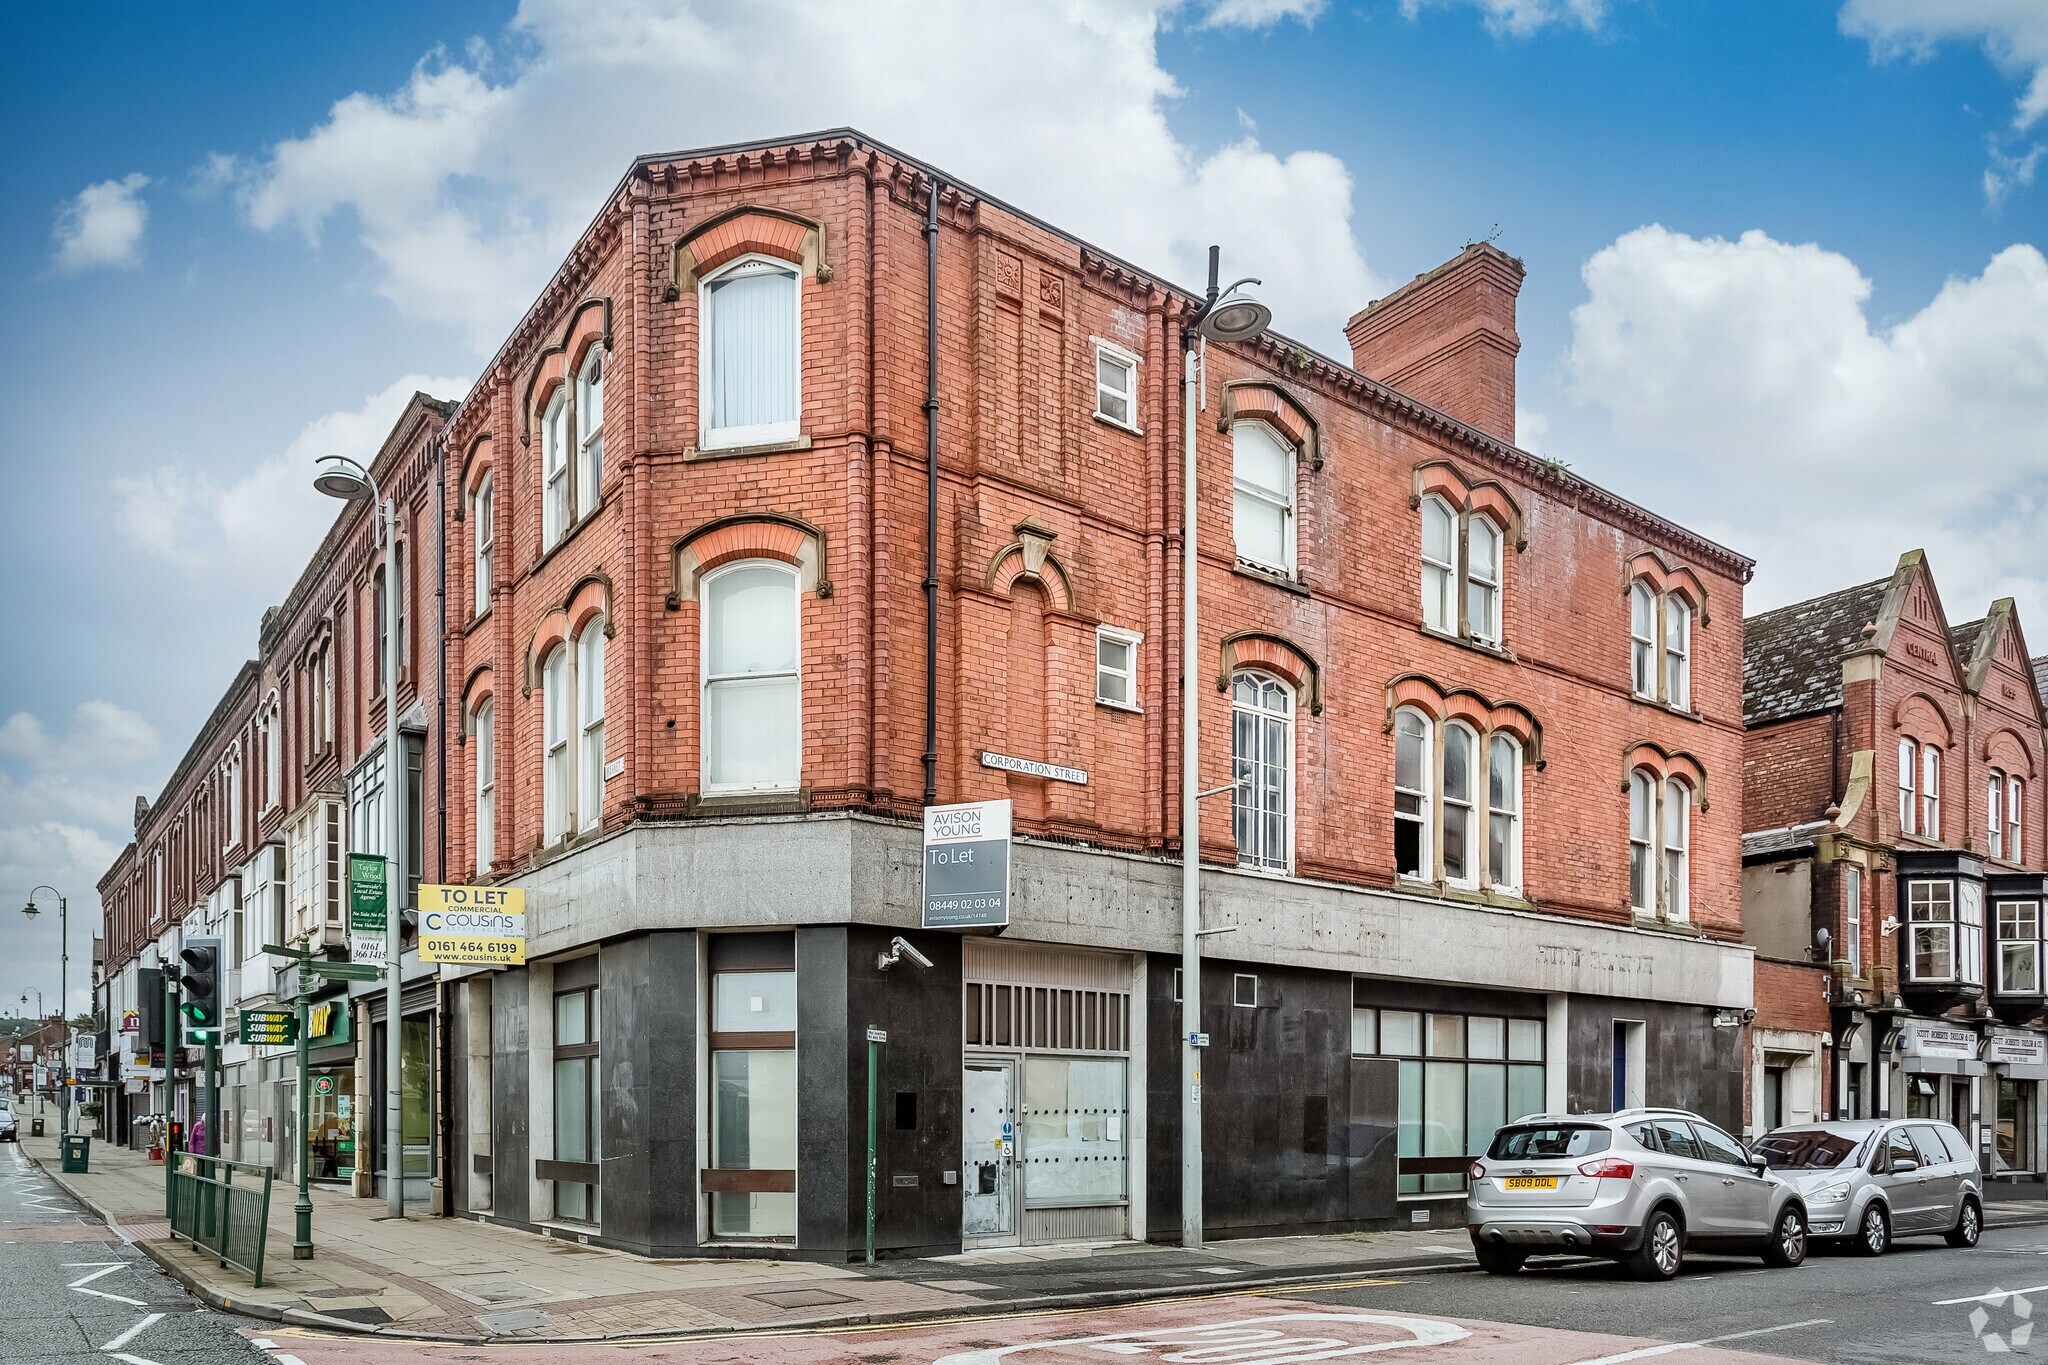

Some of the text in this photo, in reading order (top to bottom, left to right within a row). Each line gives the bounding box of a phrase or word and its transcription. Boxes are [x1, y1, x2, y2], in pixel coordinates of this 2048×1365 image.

[984, 753, 1086, 782] CORPORATION STREET
[933, 810, 980, 825] AVISON
[933, 823, 980, 837] YOUNG
[929, 848, 974, 865] To Let
[358, 863, 378, 872] Taylor
[361, 871, 381, 880] Wood
[440, 889, 508, 905] TO LET
[929, 898, 1001, 910] 08449 02 03 04
[447, 905, 503, 914] COMMERCIAL
[361, 942, 379, 950] 0161
[428, 940, 517, 953] 0161 464 6199
[353, 950, 387, 959] 366 1415
[434, 954, 511, 962] www.cousins.uk
[247, 1013, 288, 1023] SUBWAY
[247, 1024, 288, 1033] SUBWAY
[1916, 1029, 1930, 1038] SCOTT
[247, 1034, 288, 1043] SUBWAY
[1509, 1178, 1552, 1188] SB09 DDL
